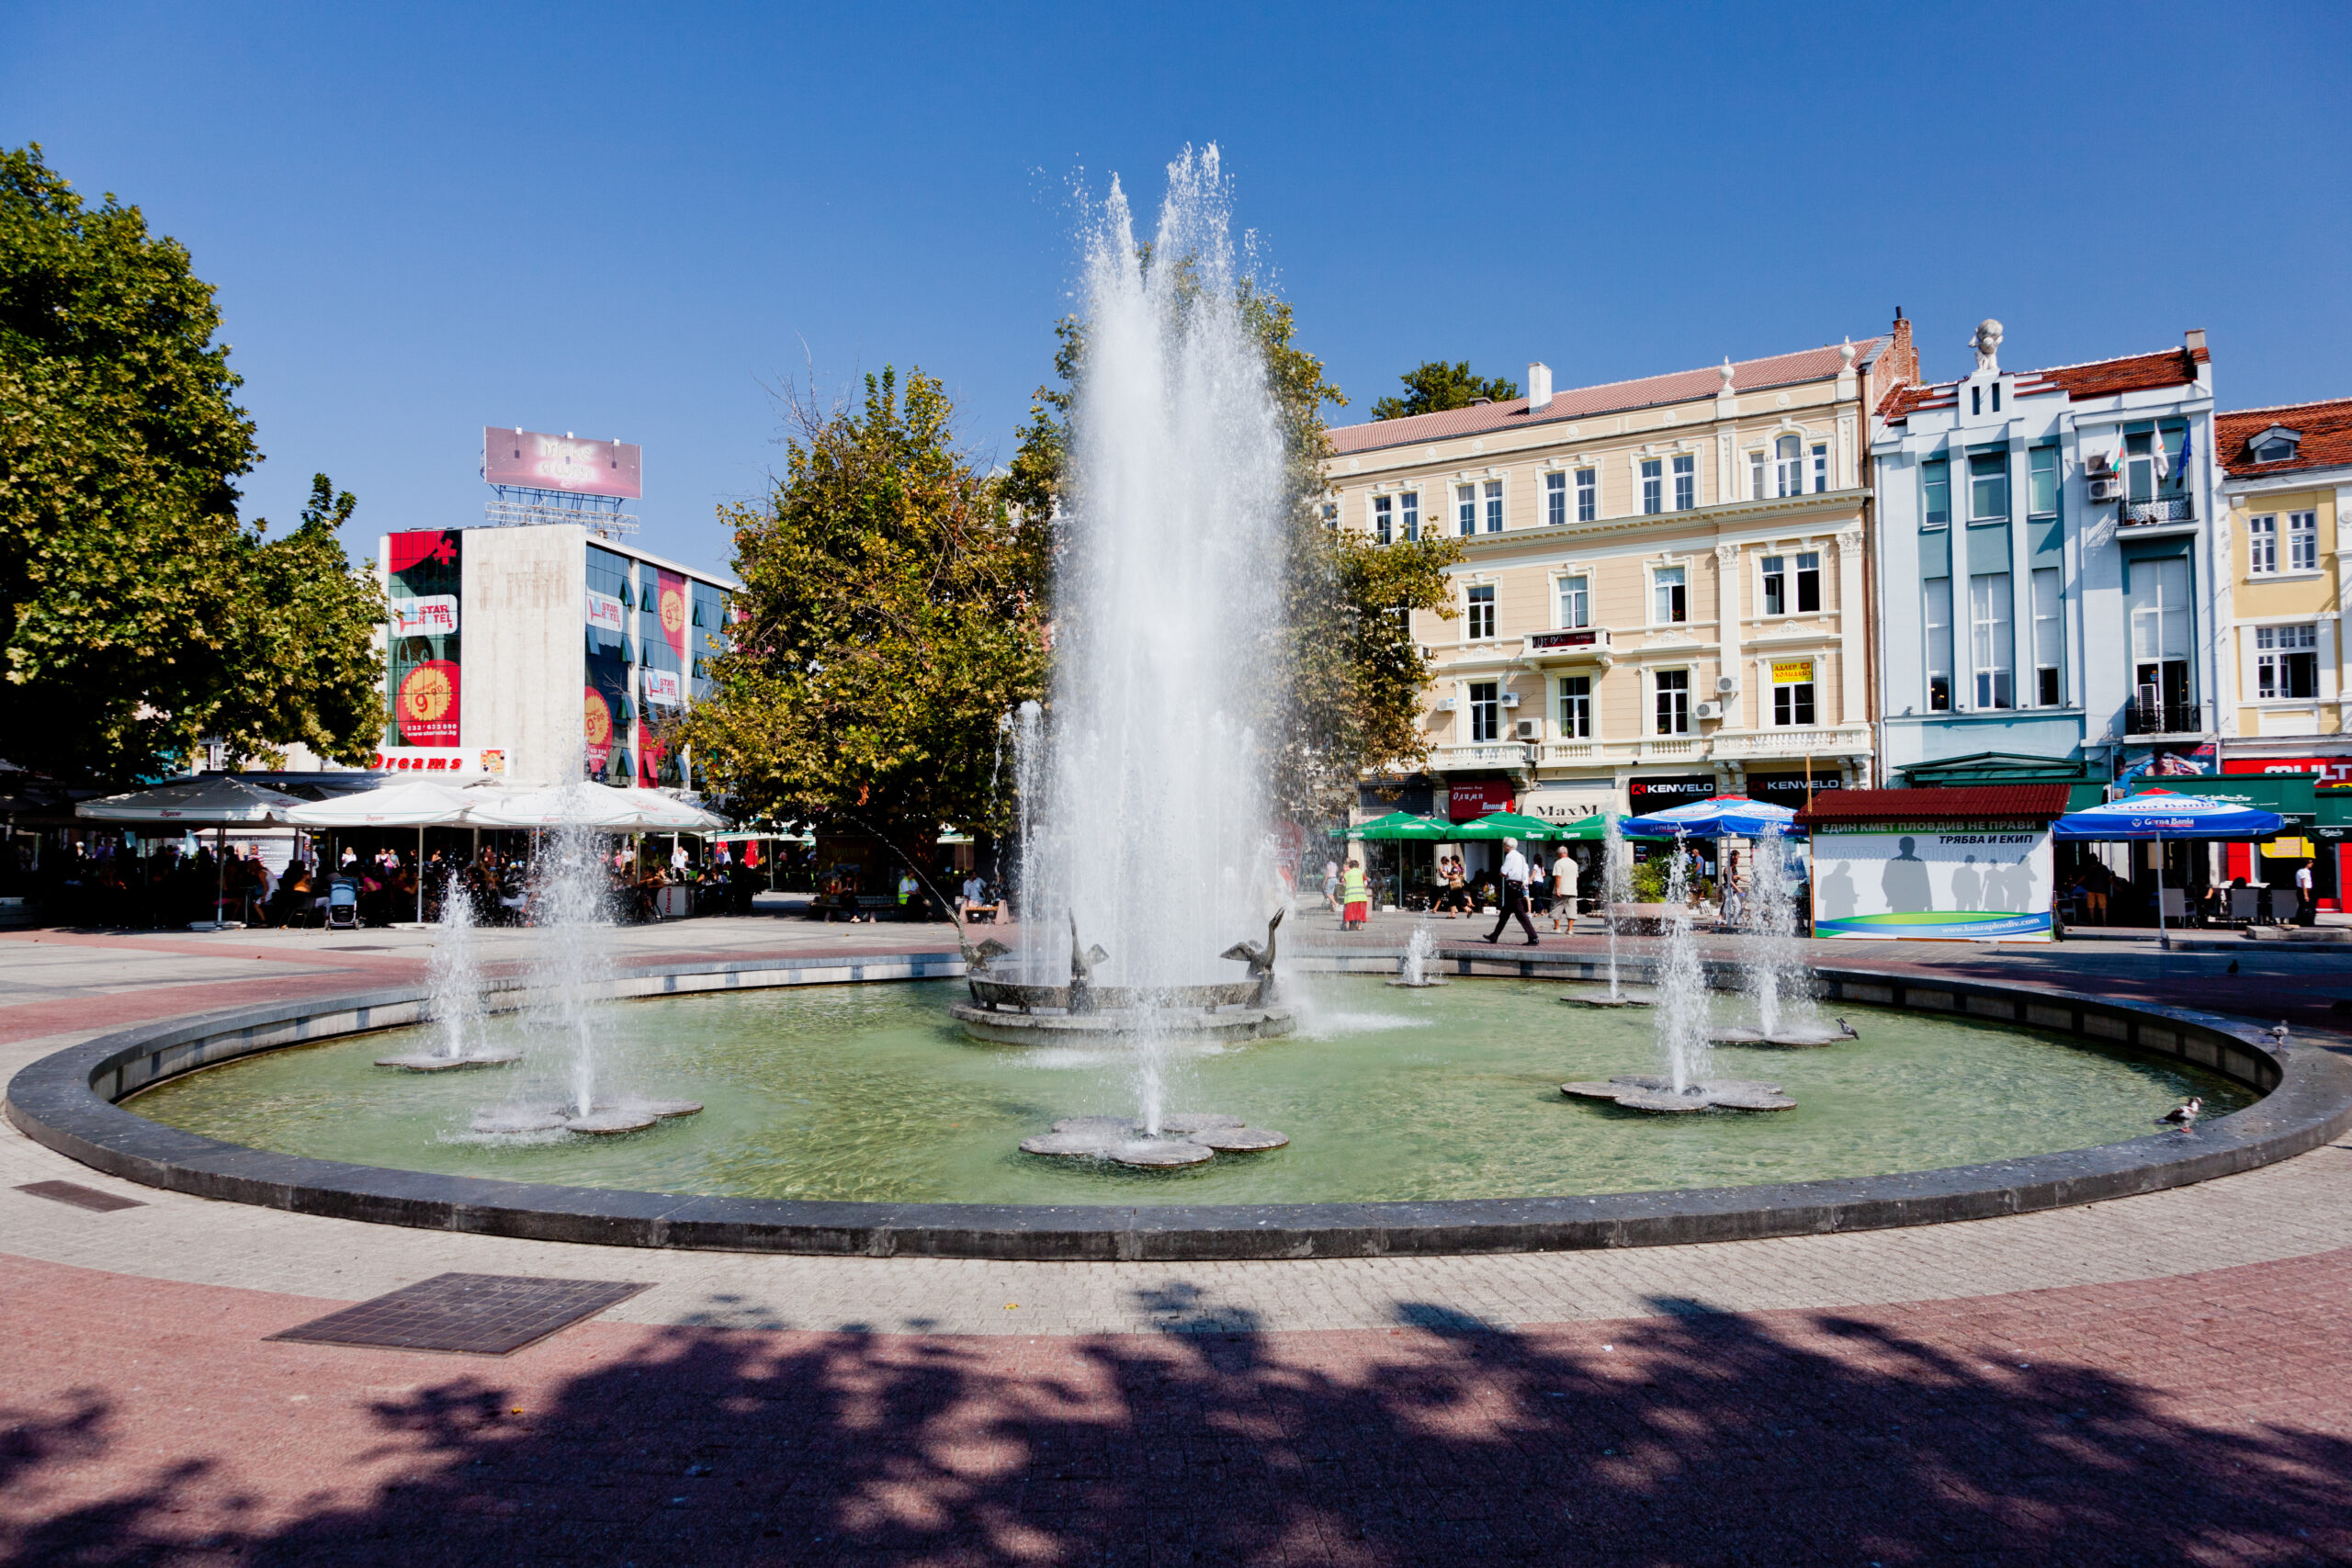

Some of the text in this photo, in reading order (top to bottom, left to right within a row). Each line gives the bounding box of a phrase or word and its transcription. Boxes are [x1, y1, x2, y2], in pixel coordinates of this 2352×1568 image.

[418, 604, 448, 615] STAR
[602, 602, 618, 614] STAR
[418, 614, 453, 625] HOTEL
[601, 611, 621, 624] HOTEL
[659, 678, 675, 688] STAR
[659, 687, 677, 696] HOTEL
[369, 752, 462, 771] Dreams
[1647, 784, 1713, 794] KENVELO
[1767, 779, 1838, 790] KENVELO
[1535, 805, 1598, 817] MaxM
[1822, 820, 2036, 834] ЕДИН КМЕТ ПЛОВДИВ НЕ ПРАВИ
[1939, 835, 2033, 844] ТРЯБВА И ЕКИП
[1941, 918, 2040, 932] www.kauzaplovdiv.com
